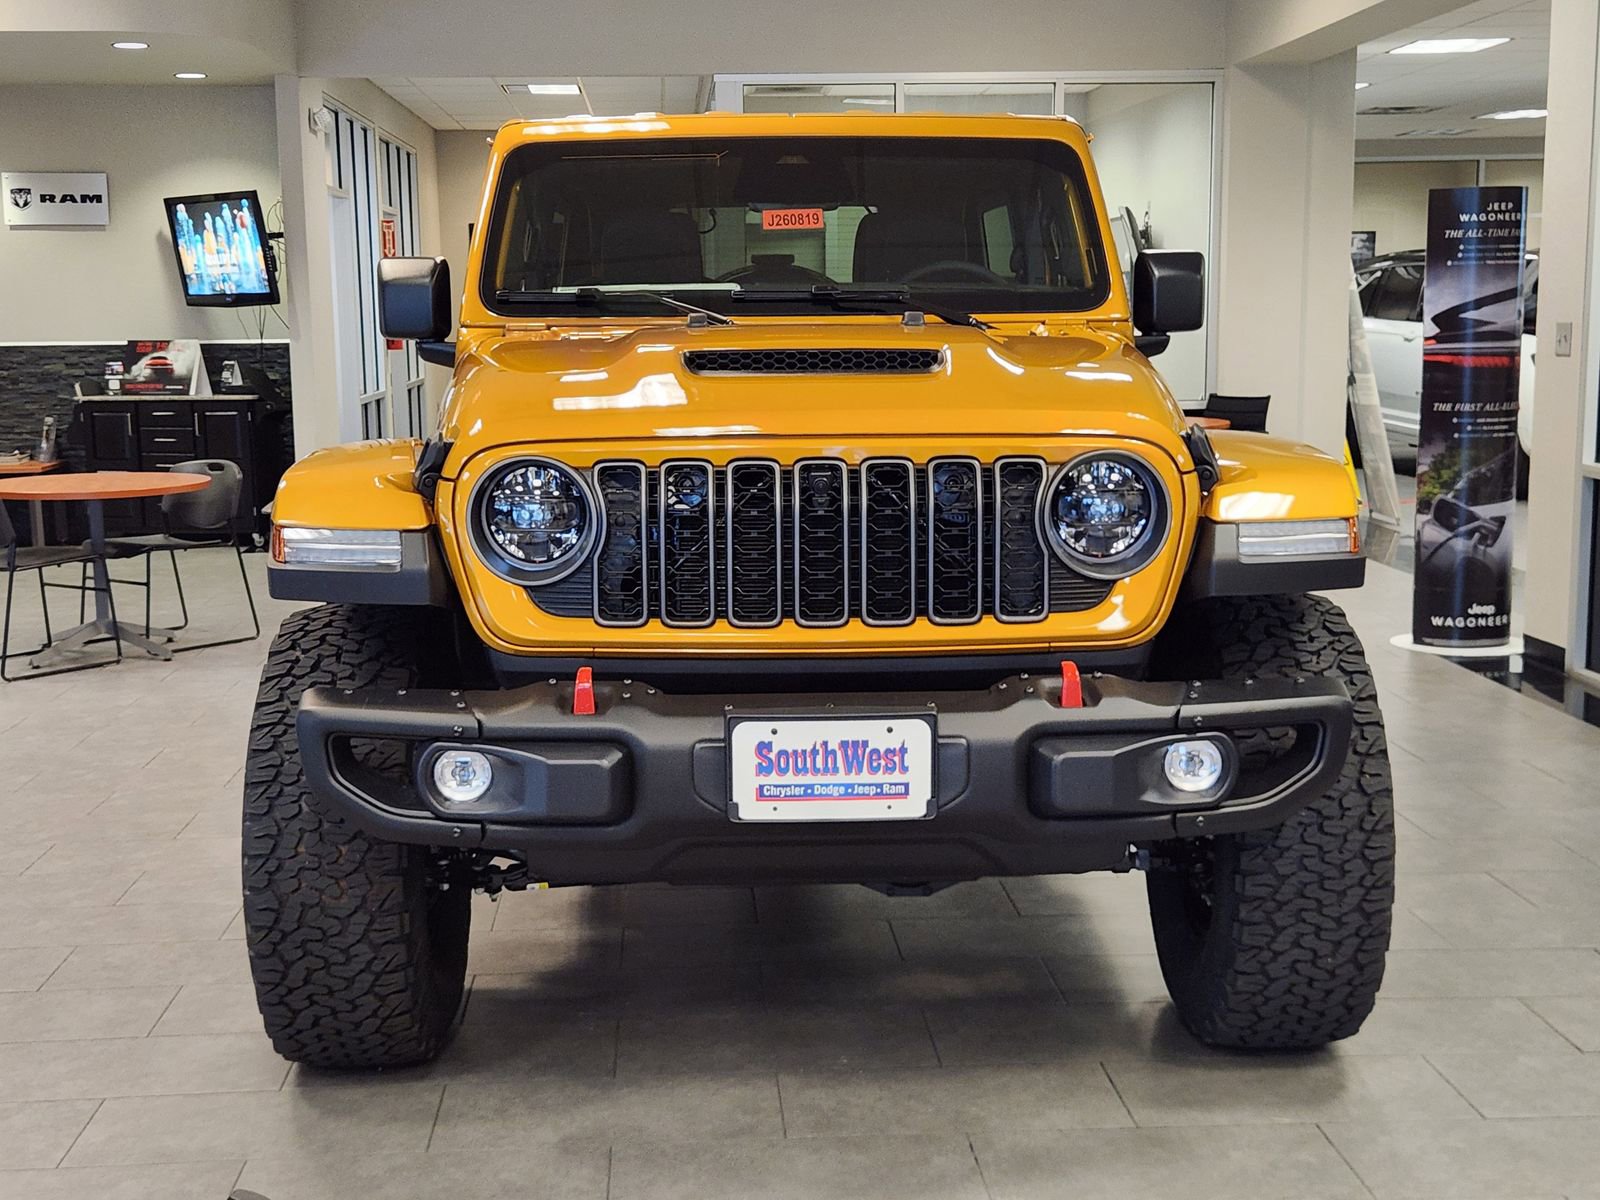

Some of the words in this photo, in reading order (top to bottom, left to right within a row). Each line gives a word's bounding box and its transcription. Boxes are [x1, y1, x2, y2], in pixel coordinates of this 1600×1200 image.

[40, 194, 103, 204] RAM
[1487, 202, 1514, 211] JEEP
[768, 213, 820, 227] J260819
[1444, 229, 1464, 239] THE
[1433, 402, 1452, 412] THE
[1454, 402, 1482, 412] FIRST
[1467, 603, 1496, 615] Jeep
[1430, 614, 1508, 628] WAGONEER
[755, 739, 909, 777] SouthWest
[763, 785, 805, 798] Chrysler
[814, 784, 845, 796] Dodge
[853, 784, 878, 797] Jeep
[883, 783, 905, 795] Ram
